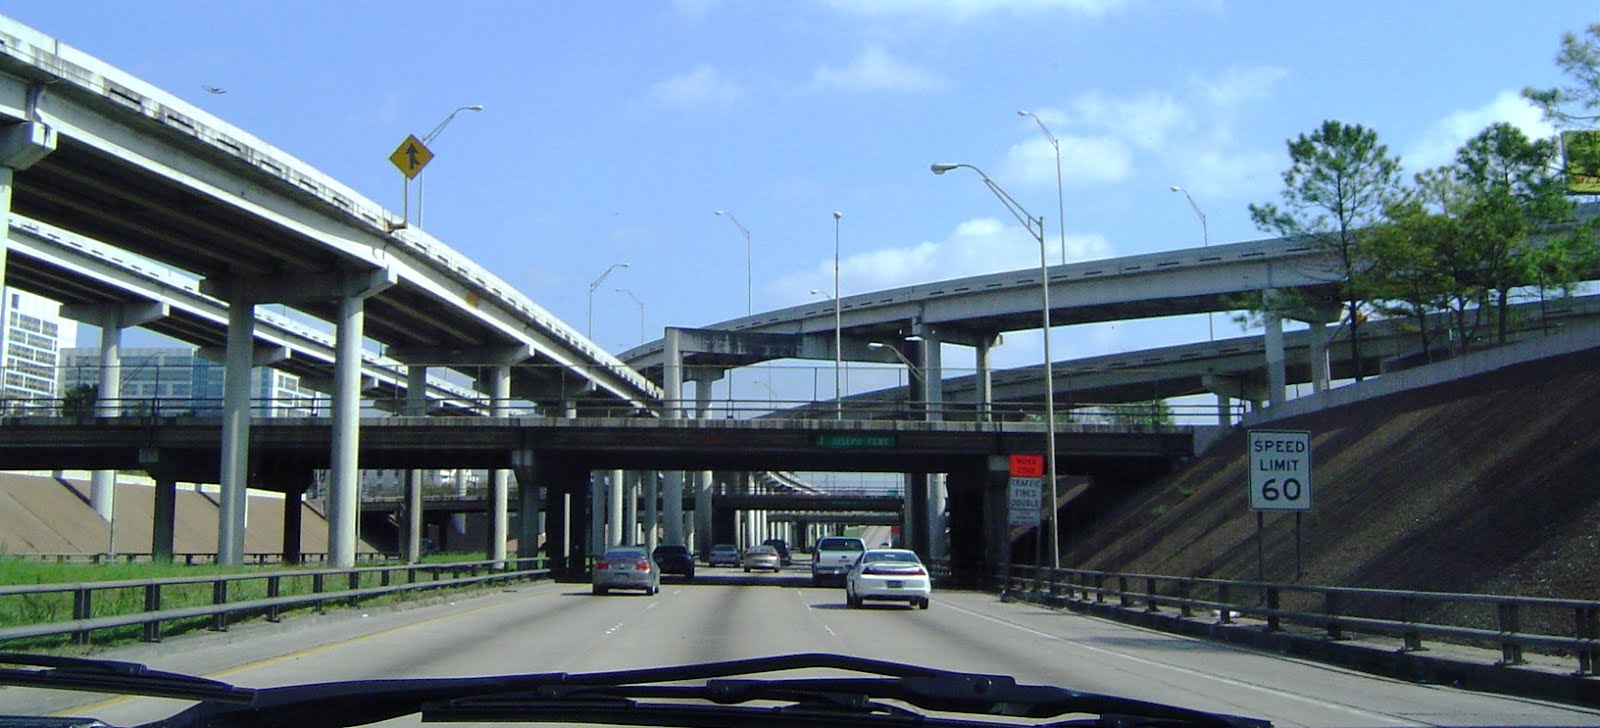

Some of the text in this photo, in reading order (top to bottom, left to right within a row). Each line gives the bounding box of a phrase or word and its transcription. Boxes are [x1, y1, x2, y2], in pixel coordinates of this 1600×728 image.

[1254, 440, 1305, 452] SPEED
[1260, 459, 1299, 471] LIMIT
[1012, 479, 1041, 488] TRAFFIC
[1015, 488, 1036, 498] FINES
[1262, 478, 1301, 501] 60
[1011, 498, 1039, 507] DOUBLE
